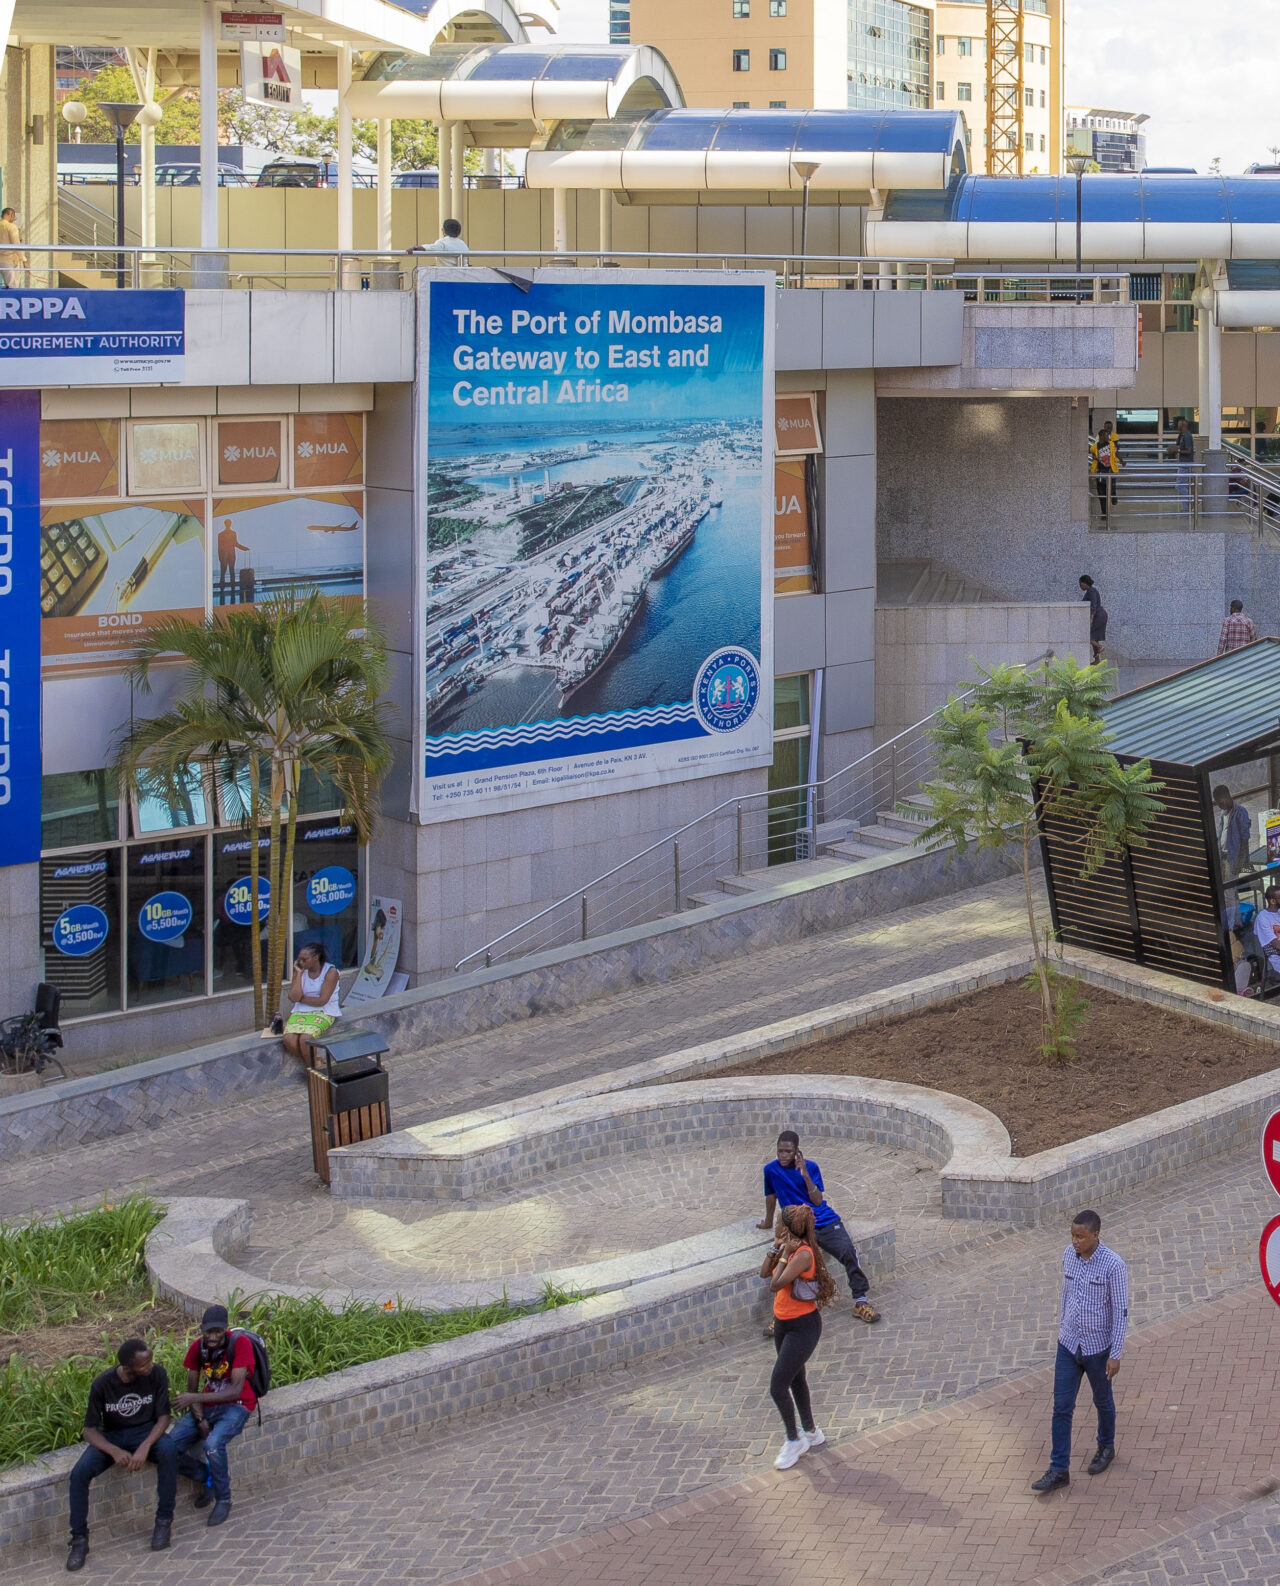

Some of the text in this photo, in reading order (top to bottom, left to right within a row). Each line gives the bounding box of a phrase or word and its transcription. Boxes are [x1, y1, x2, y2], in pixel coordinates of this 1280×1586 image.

[264, 82, 291, 103] EQUITY
[0, 297, 86, 320] RPPA
[453, 309, 722, 334] The Port of Mombasa
[99, 335, 182, 348] AUTHORITY
[453, 343, 709, 375] Gateway to East and
[453, 379, 629, 406] Central Africa
[789, 418, 812, 429] MUA
[63, 450, 101, 463] MUA
[159, 448, 195, 462] MUA
[243, 446, 276, 459] MUA
[315, 442, 349, 455] MUA
[98, 614, 142, 627] BOND
[64, 630, 96, 638] Insurance
[701, 656, 757, 694] KENYA PORTS
[702, 702, 752, 728] AUTHORITY
[432, 783, 446, 791] Visit
[474, 776, 493, 784] Grand
[494, 773, 518, 782] Pension
[445, 791, 461, 799] +250
[532, 777, 550, 785] Email:
[106, 1394, 153, 1412] PREDATORS
